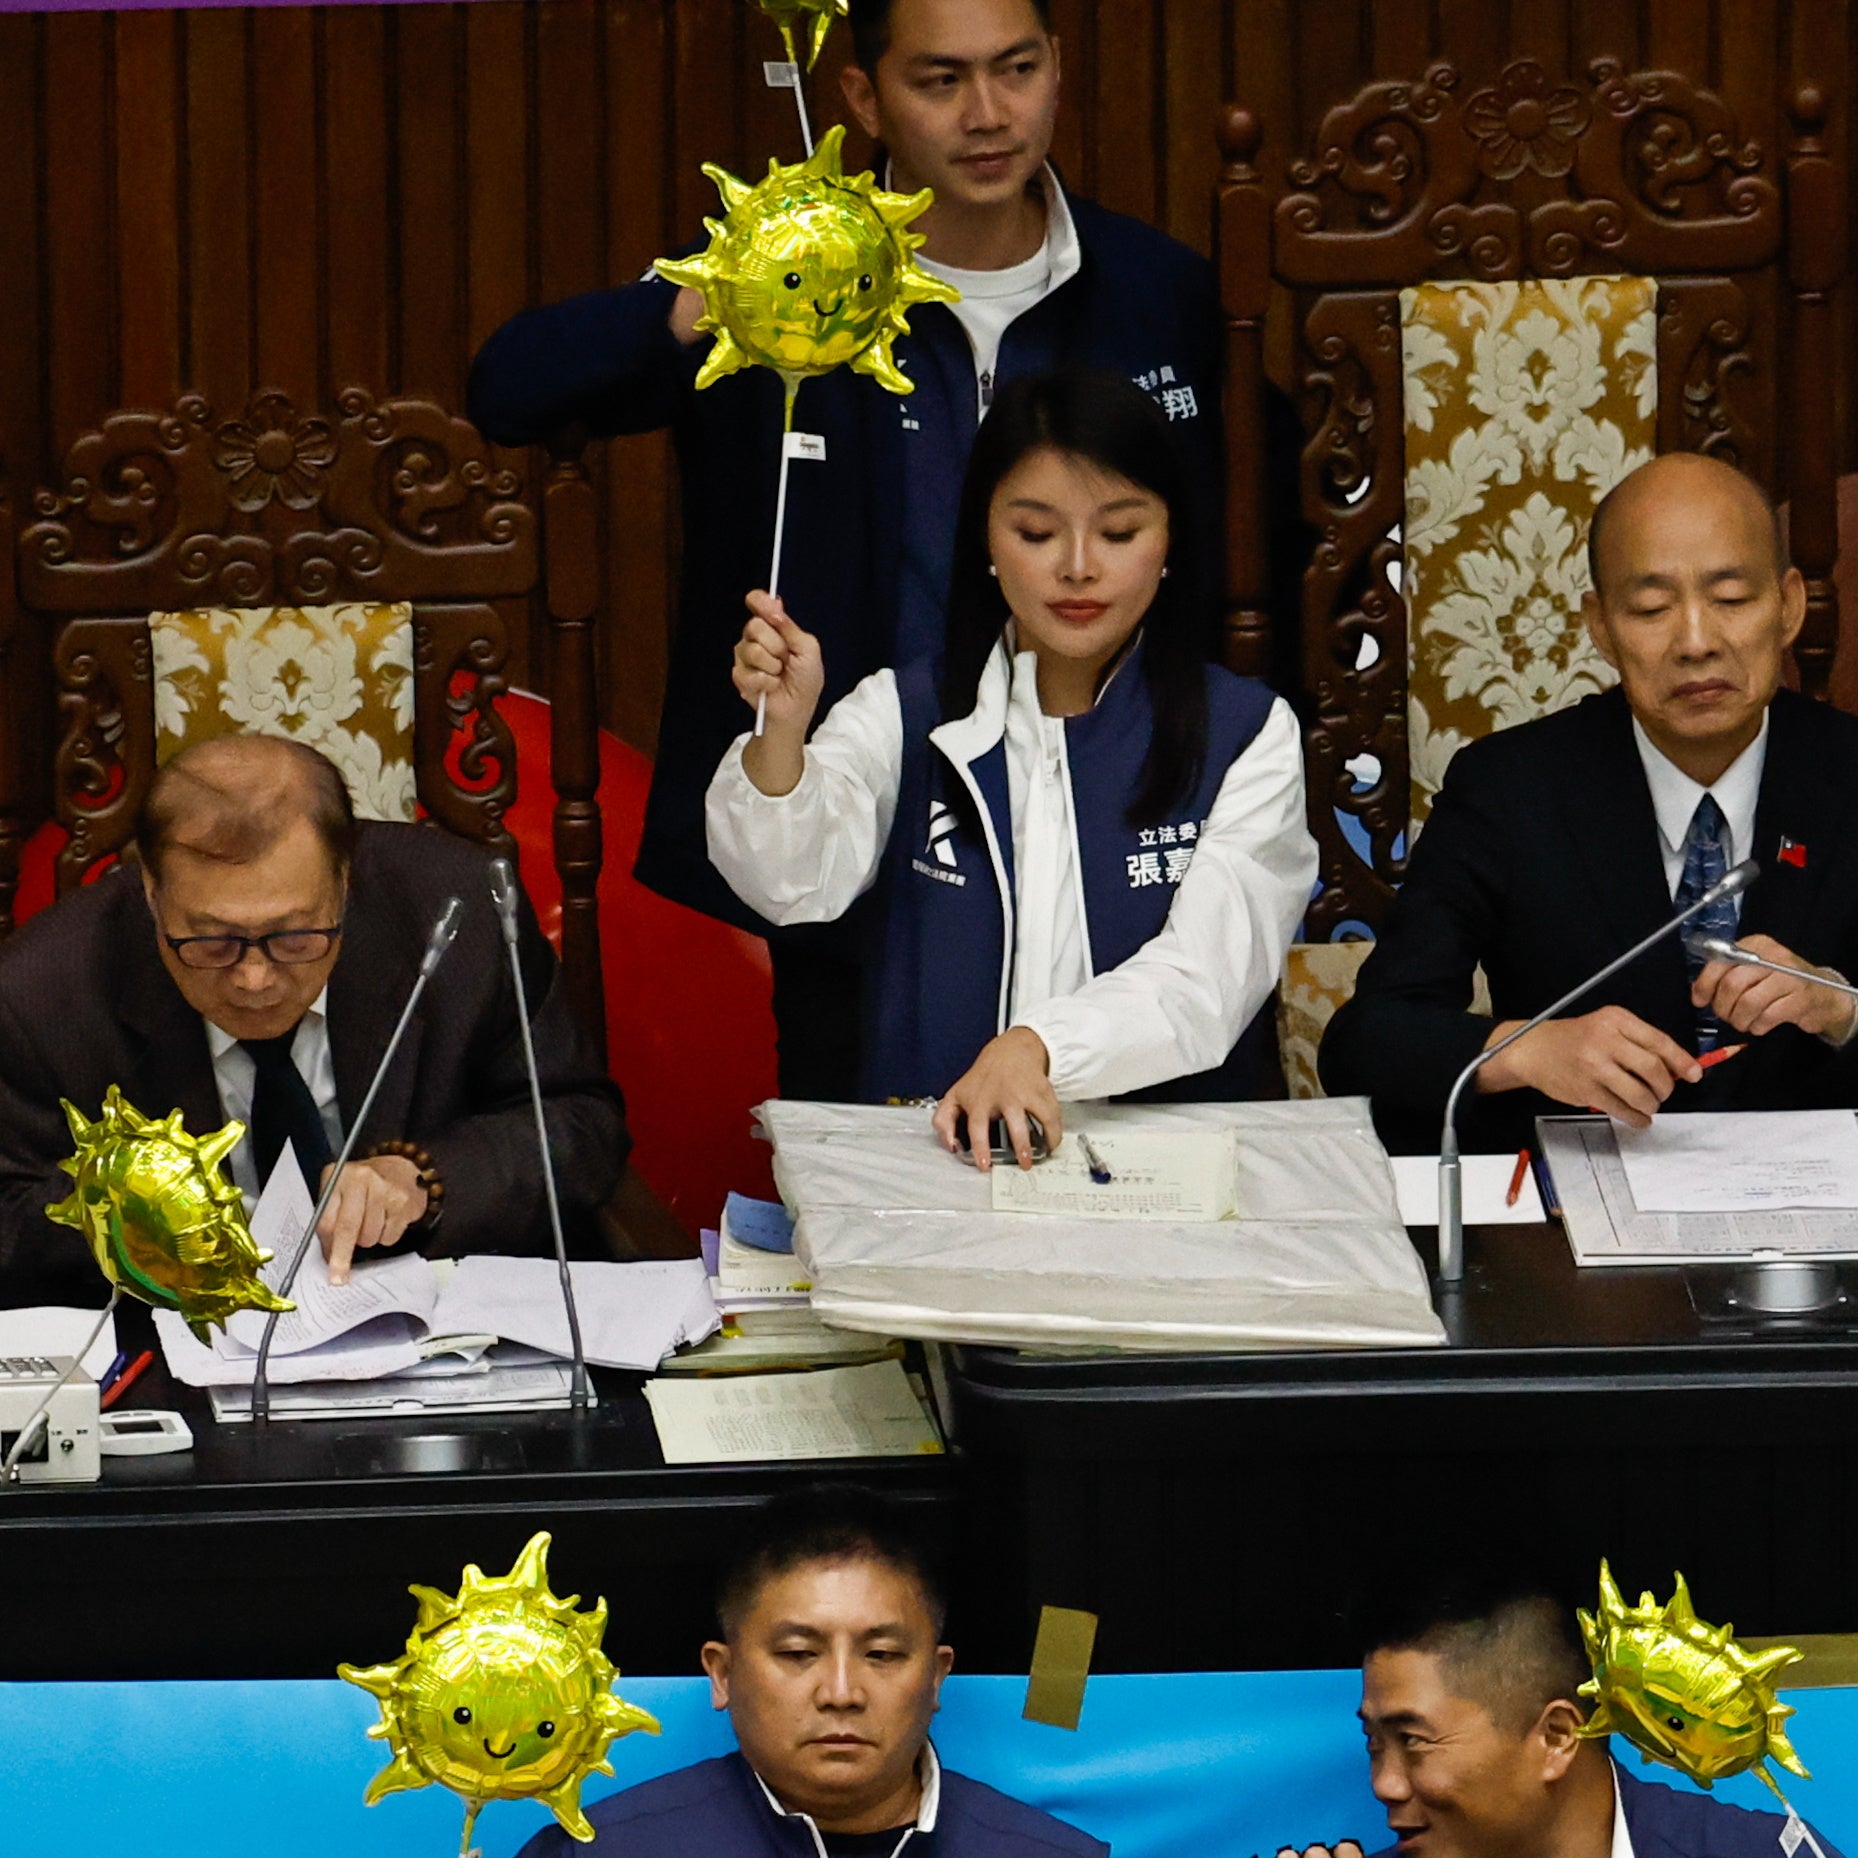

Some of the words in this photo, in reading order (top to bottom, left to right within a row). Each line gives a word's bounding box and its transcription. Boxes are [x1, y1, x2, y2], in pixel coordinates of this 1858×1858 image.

[1153, 386, 1199, 421] 翔
[1138, 821, 1207, 847] 立法委
